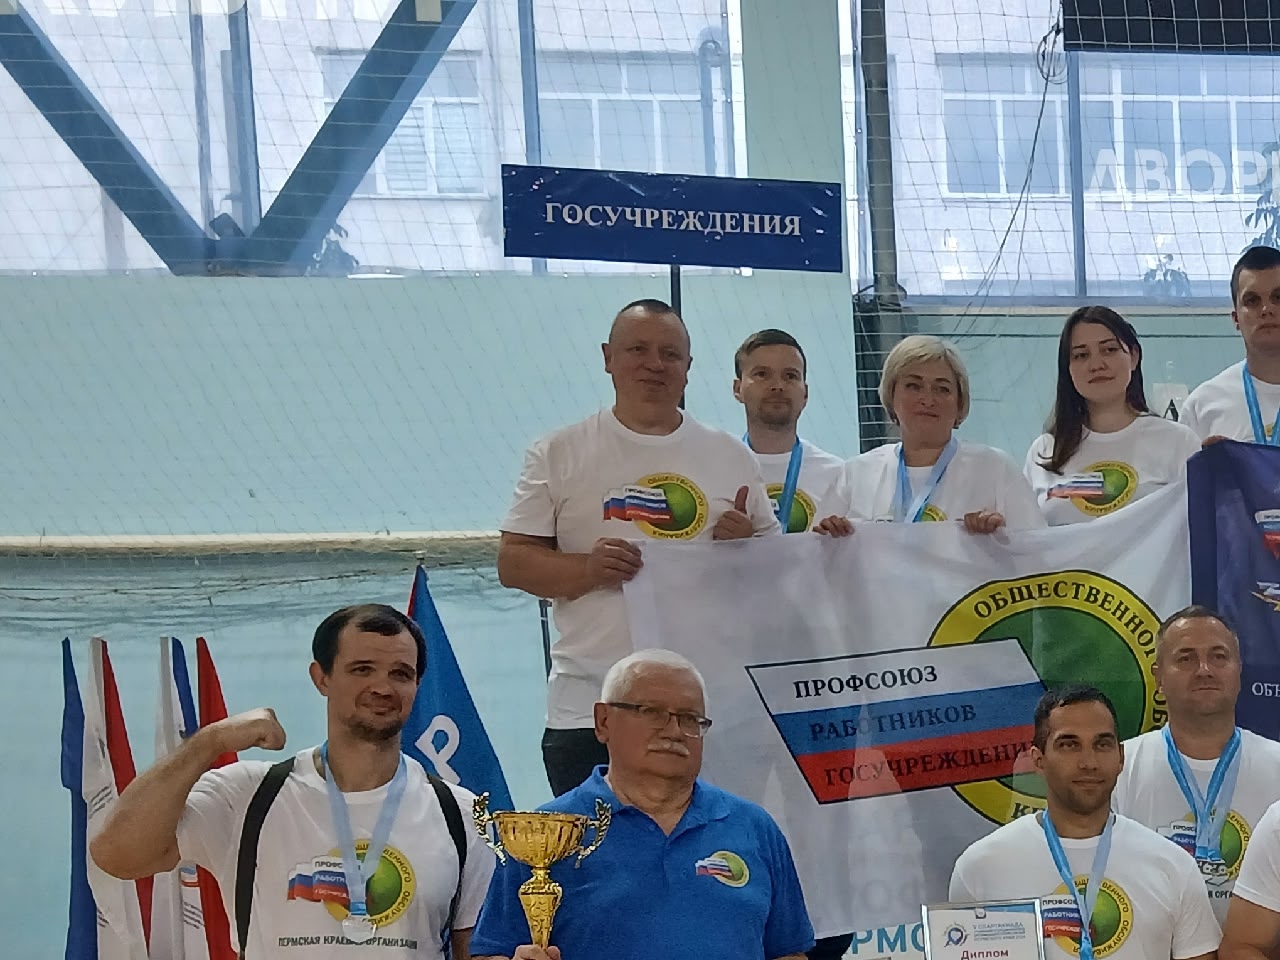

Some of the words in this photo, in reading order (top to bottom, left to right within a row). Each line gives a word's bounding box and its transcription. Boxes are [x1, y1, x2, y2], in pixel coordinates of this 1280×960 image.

[545, 202, 802, 236] ГОСУЧРЕЖДЕНИЯ
[973, 580, 1158, 675] ОБЩЕСТВЕННО
[793, 665, 938, 699] ПРОФСОЮЗ
[809, 704, 977, 741] РАБОТНИКОВ
[824, 739, 1034, 786] ГОСУЧРЕЖДЕНИ
